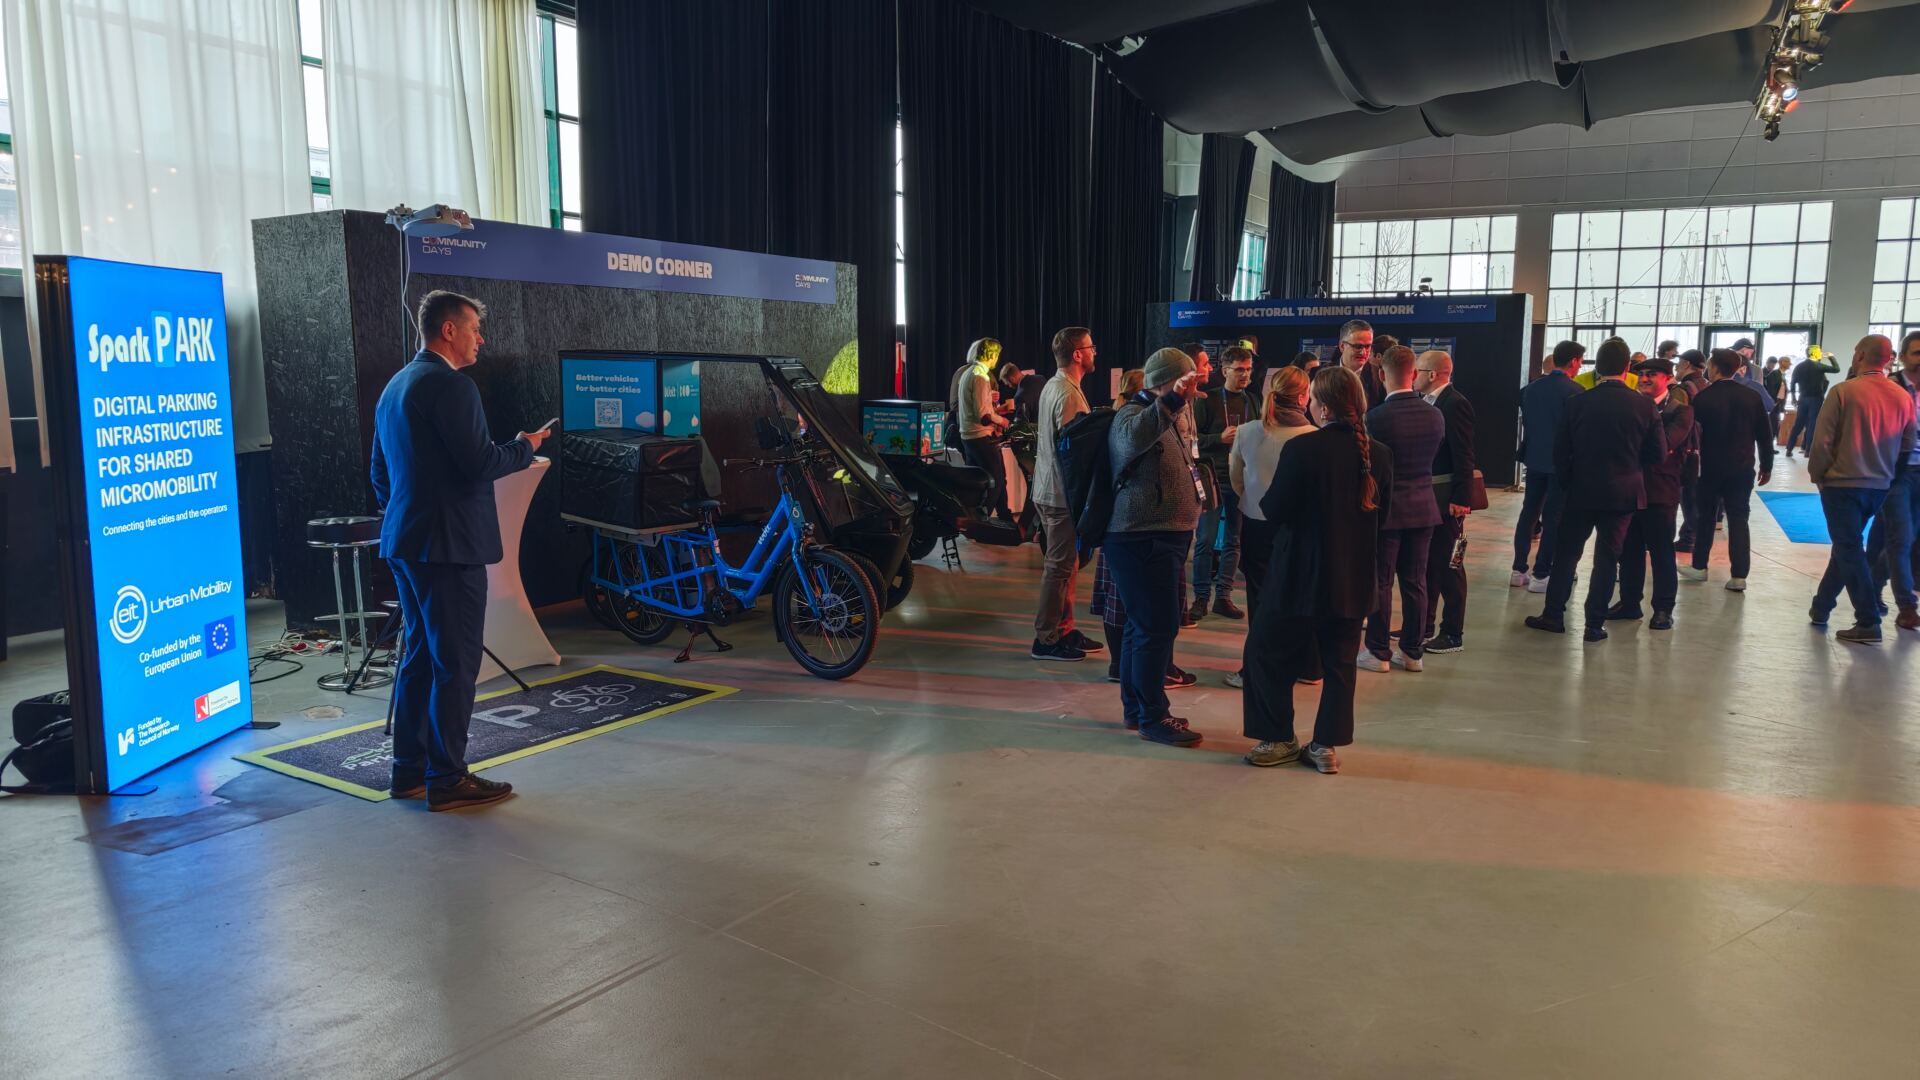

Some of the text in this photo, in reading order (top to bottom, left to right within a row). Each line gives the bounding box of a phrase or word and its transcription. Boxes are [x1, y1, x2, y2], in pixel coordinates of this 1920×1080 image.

[422, 245, 452, 256] DAYS
[607, 251, 713, 279] DEMO CORNER
[795, 281, 811, 289] DAYS
[1237, 304, 1415, 318] DOCTORAL TRAINING NETWORK
[576, 374, 639, 383] Better vehicles
[576, 384, 641, 394] for better cities
[93, 392, 217, 417] DIGITAL PARKING
[96, 418, 223, 447] INFRASTRUCTURE
[98, 448, 193, 478] FOR SHARED
[100, 471, 218, 508] MICROMOBILITY
[103, 504, 228, 536] Connecting the cities and the operators
[118, 580, 232, 623] eit Urban Mobility
[139, 633, 201, 664] Co-funded by the
[144, 648, 202, 678] European Union
[138, 717, 156, 731] Funded
[471, 704, 541, 729] P
[138, 729, 149, 739] The
[139, 733, 157, 746] Council
